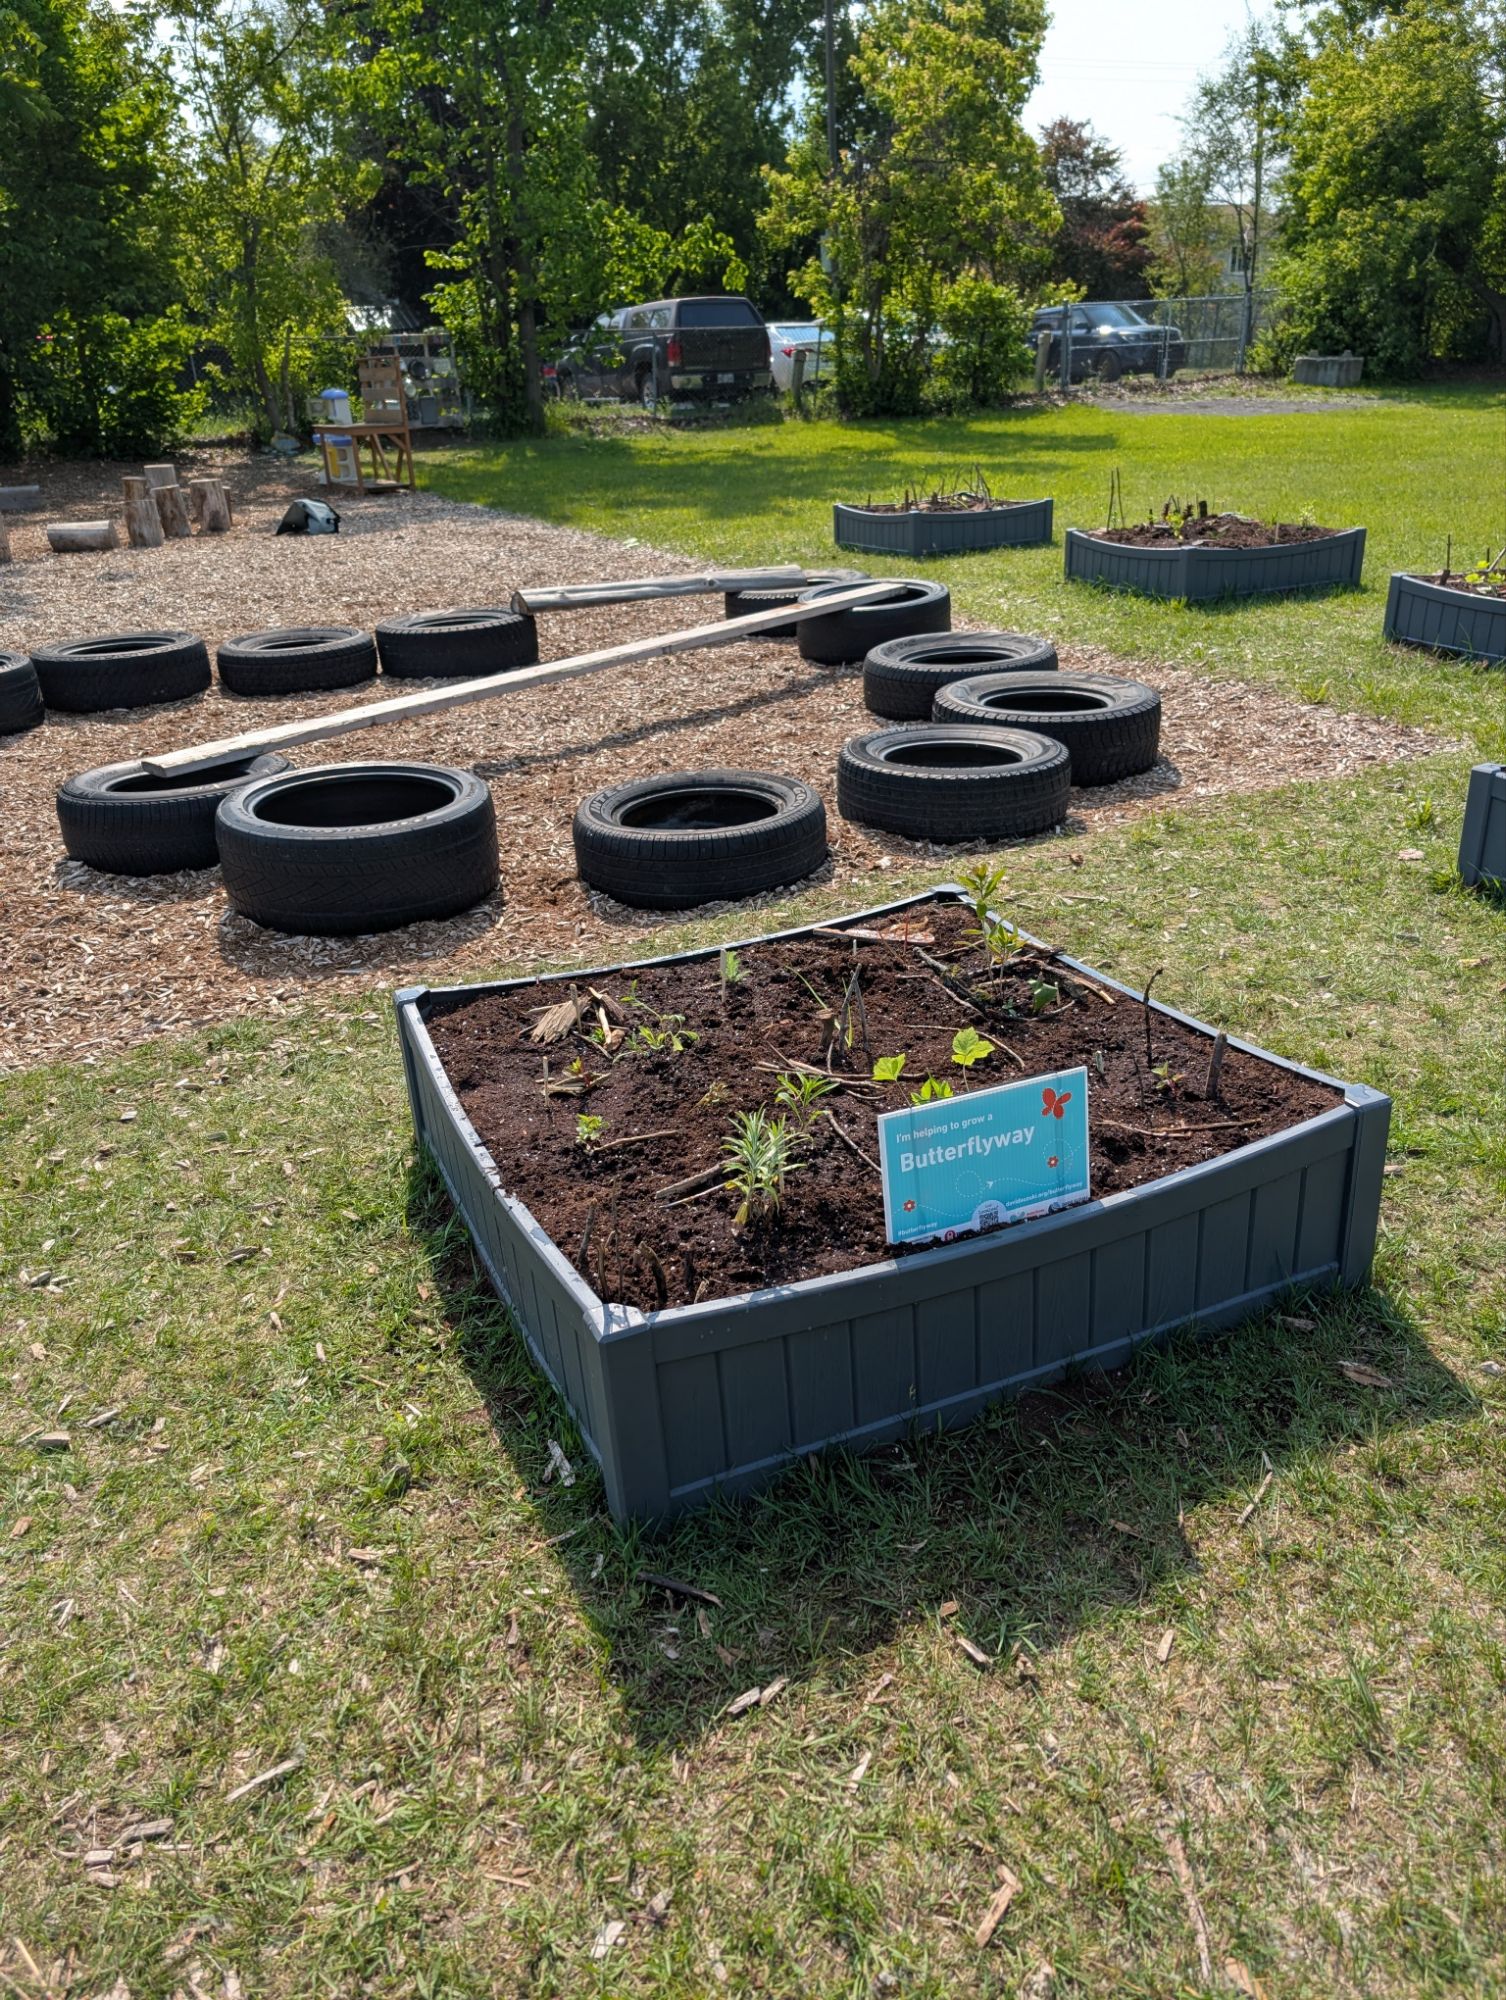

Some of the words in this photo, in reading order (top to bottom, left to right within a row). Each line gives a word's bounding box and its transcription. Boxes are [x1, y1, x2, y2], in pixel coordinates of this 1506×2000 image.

[896, 1133, 911, 1144] I'm
[913, 1124, 948, 1139] helping
[950, 1121, 960, 1130] to
[961, 1116, 985, 1129] grow
[987, 1113, 993, 1121] a
[900, 1125, 1036, 1173] Butterflyway
